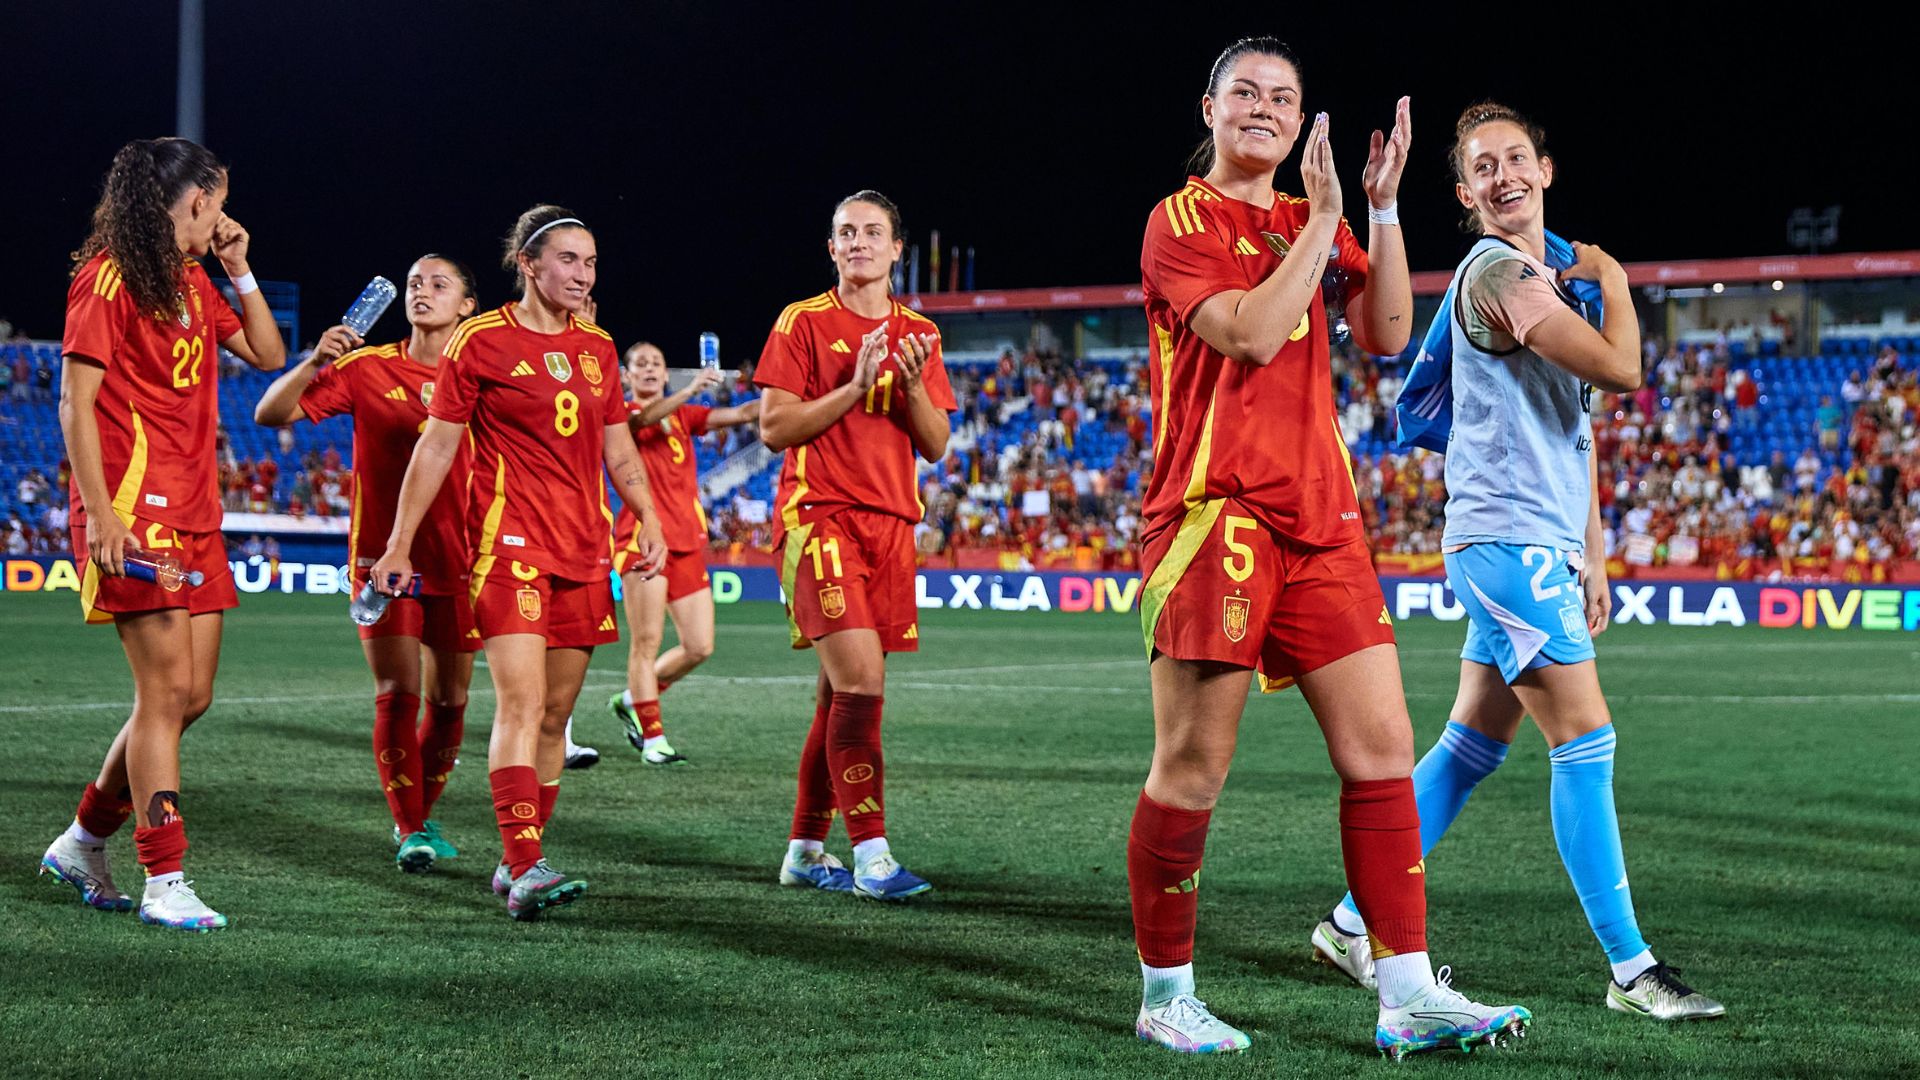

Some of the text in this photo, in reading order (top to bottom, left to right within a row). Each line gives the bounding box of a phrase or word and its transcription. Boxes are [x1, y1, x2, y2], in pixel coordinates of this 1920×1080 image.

[172, 335, 204, 389] 22
[554, 389, 580, 437] 8
[865, 370, 894, 415] 11
[667, 435, 685, 465] 9
[804, 536, 844, 580] 11
[1223, 514, 1258, 583] 5
[0, 558, 82, 592] DA
[228, 554, 352, 595] ÚTB
[947, 574, 982, 610] X
[1521, 545, 1575, 602] 2
[1614, 585, 1656, 625] X
[1668, 586, 1746, 627] LA
